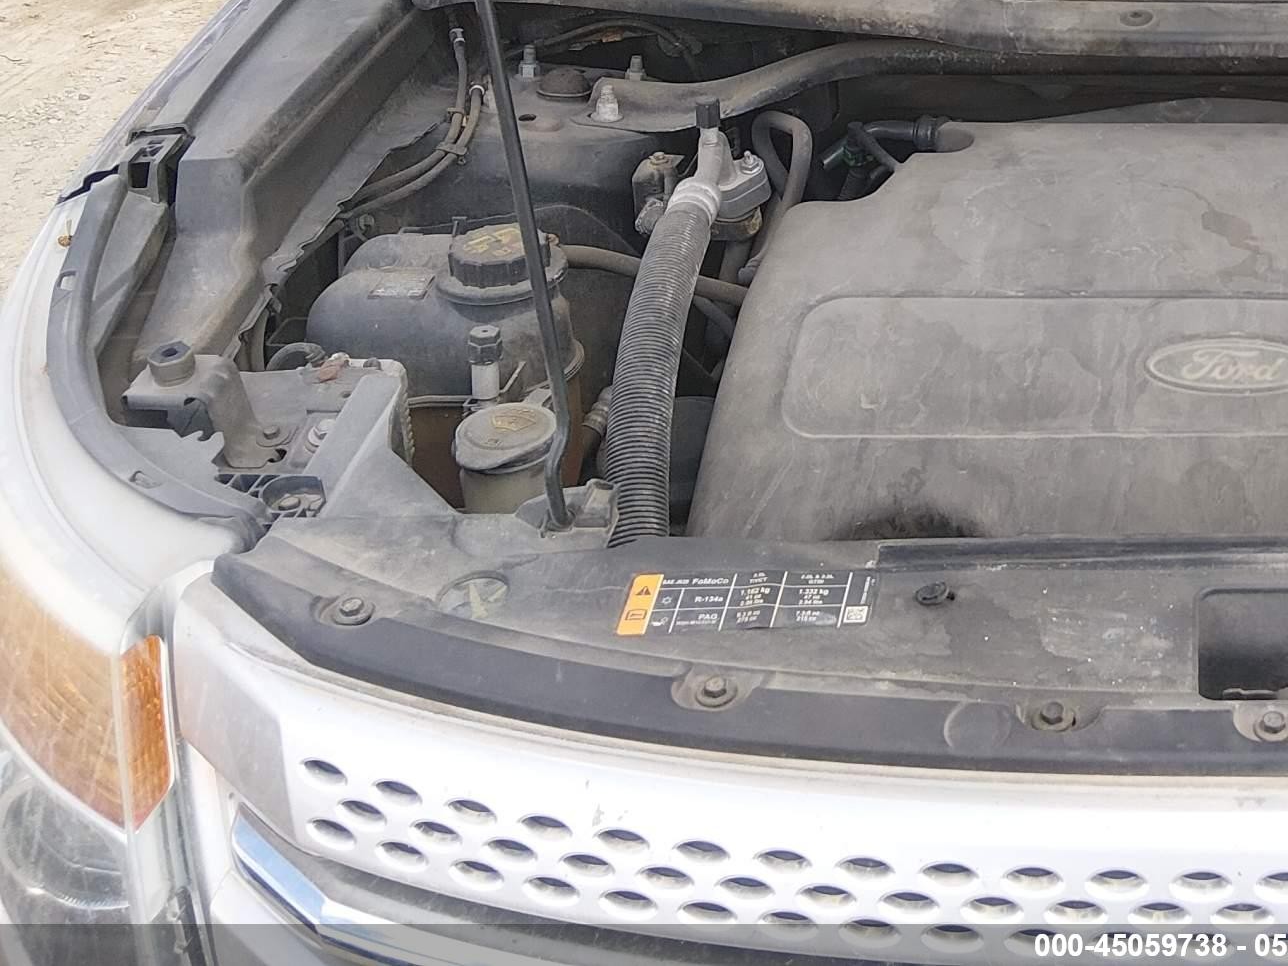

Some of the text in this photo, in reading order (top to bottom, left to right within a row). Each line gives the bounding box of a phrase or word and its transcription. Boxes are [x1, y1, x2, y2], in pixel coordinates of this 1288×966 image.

[1181, 348, 1288, 382] Ford
[691, 577, 729, 585] FoMoCo
[819, 588, 829, 596] kg
[694, 595, 724, 603] R-134a
